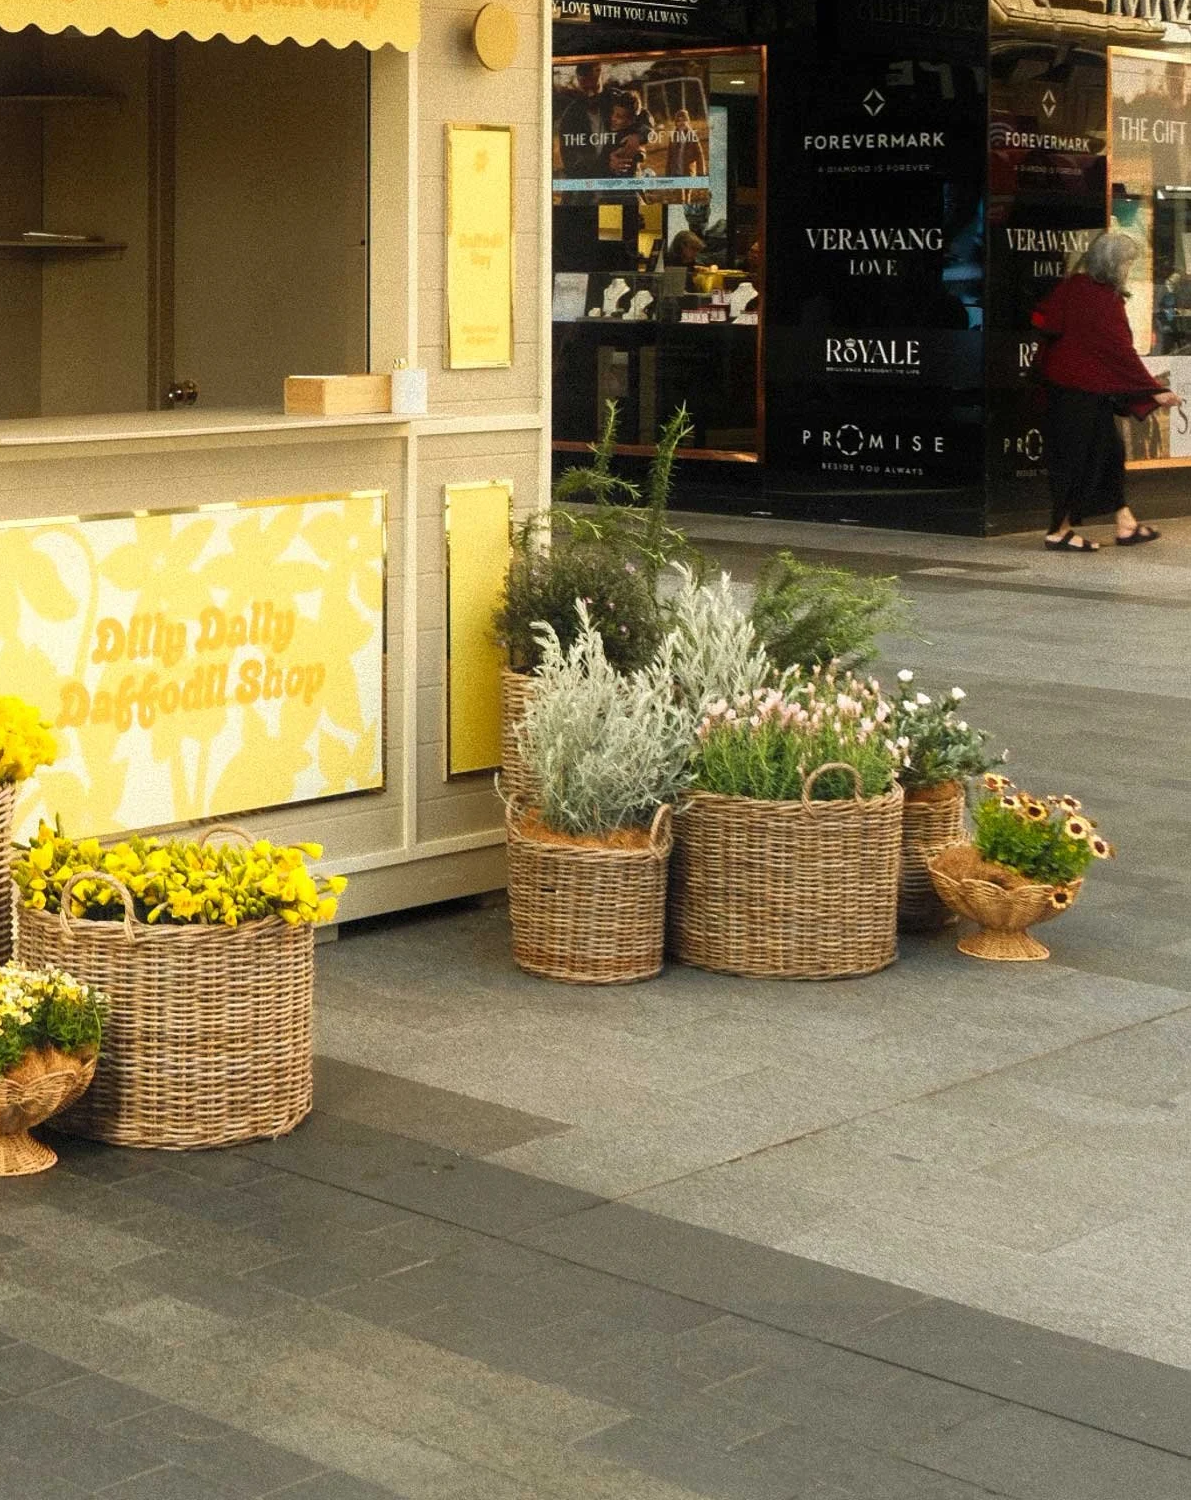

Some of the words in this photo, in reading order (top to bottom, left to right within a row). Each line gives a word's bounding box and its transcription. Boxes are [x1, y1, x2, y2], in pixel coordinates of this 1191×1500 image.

[562, 0, 591, 16] LOVE
[593, 3, 621, 19] WITH
[624, 7, 645, 21] YOU
[646, 10, 688, 25] ALWAYS
[563, 133, 586, 147] THE
[589, 132, 618, 146] GIFT
[647, 131, 665, 144] OF
[669, 130, 700, 143] TIME
[1119, 116, 1149, 142] THE
[1153, 120, 1186, 145] GIFT
[804, 132, 945, 150] FOREVERMARK
[1005, 132, 1090, 151] FOREVERMARK
[850, 259, 898, 276] LOVE
[1033, 260, 1065, 278] LOVE
[821, 462, 854, 471] BESIDE
[860, 464, 880, 473] YOU
[885, 467, 923, 476] ALWAYS
[92, 611, 186, 667] Dilly
[196, 601, 295, 653] Dally
[55, 663, 228, 732] Daffodil
[235, 657, 327, 707] Shop
